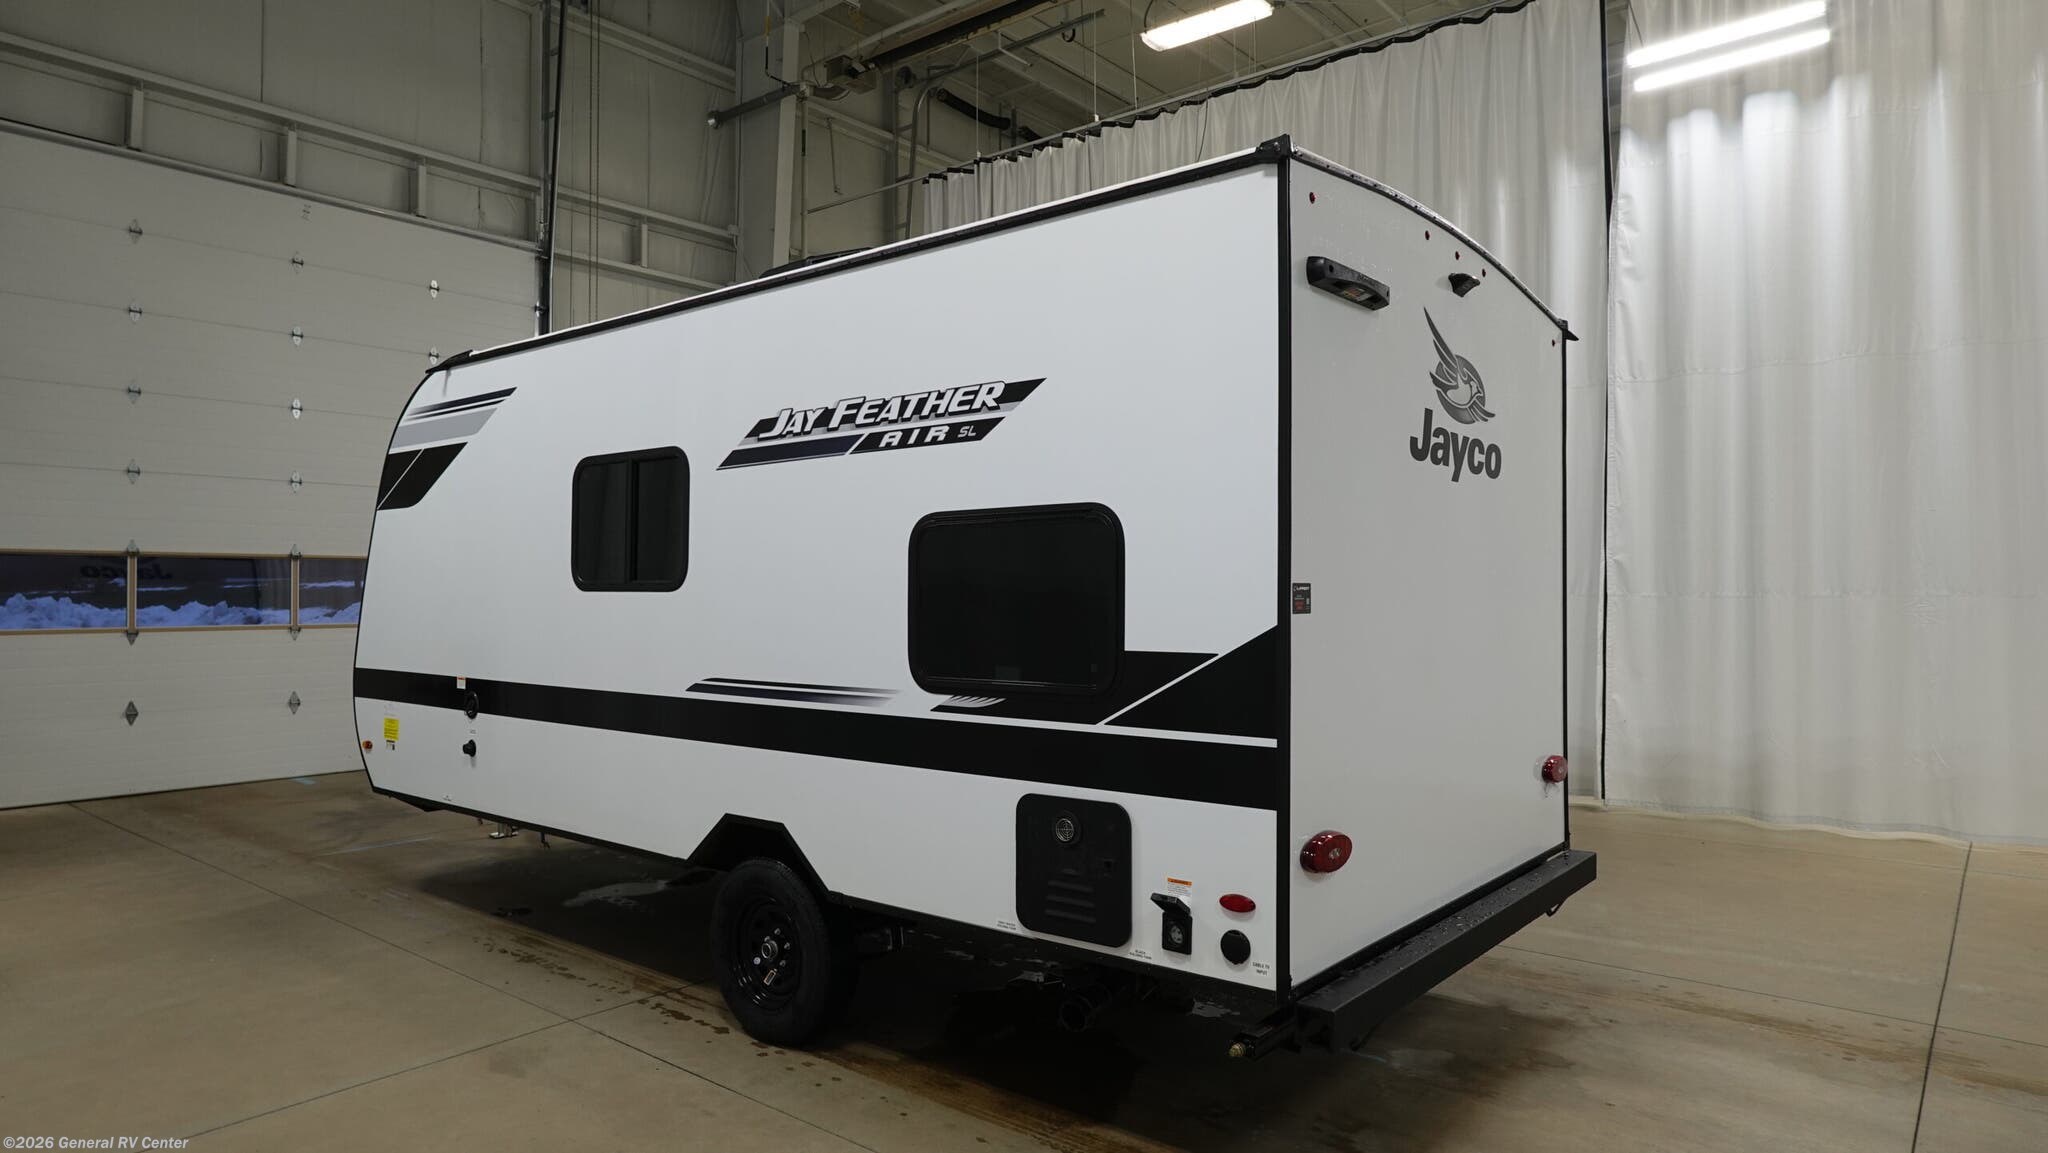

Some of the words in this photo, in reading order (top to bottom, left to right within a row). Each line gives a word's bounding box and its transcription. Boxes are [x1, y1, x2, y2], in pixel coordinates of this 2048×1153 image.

[758, 407, 828, 441] JAY
[828, 380, 1007, 432] FEATHER
[878, 425, 950, 449] AIR
[957, 425, 977, 438] SL
[1409, 407, 1502, 483] Jayco
